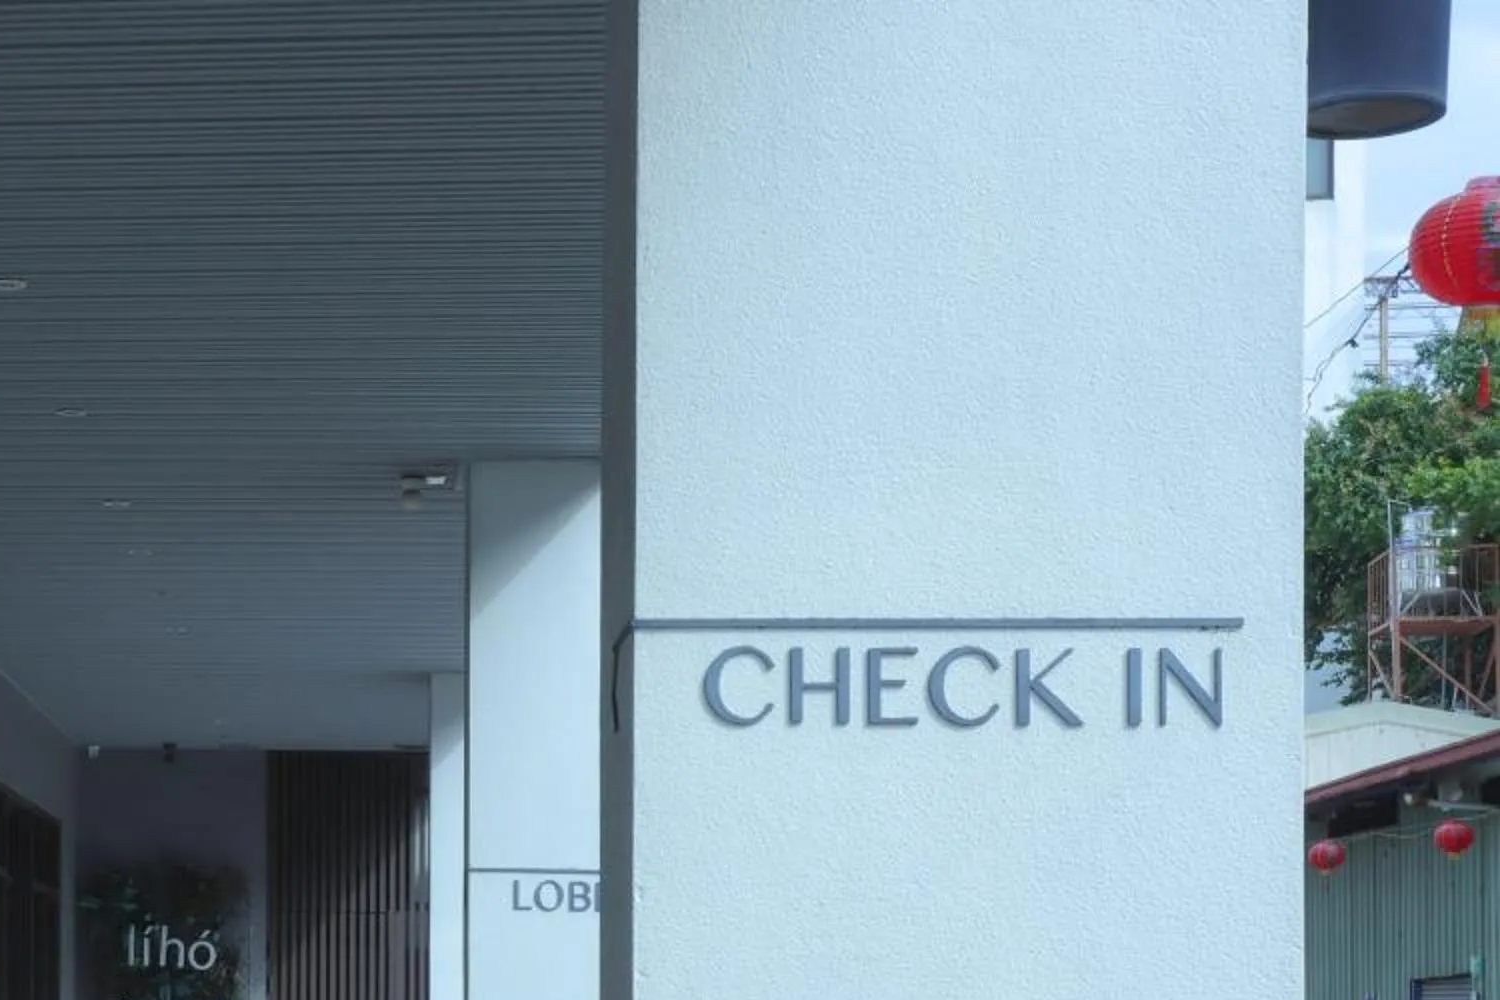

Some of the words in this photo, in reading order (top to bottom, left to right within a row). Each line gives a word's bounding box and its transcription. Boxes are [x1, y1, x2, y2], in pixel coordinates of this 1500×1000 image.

[701, 645, 1084, 730] CHECK
[1125, 647, 1223, 730] IN
[512, 879, 600, 913] LOB
